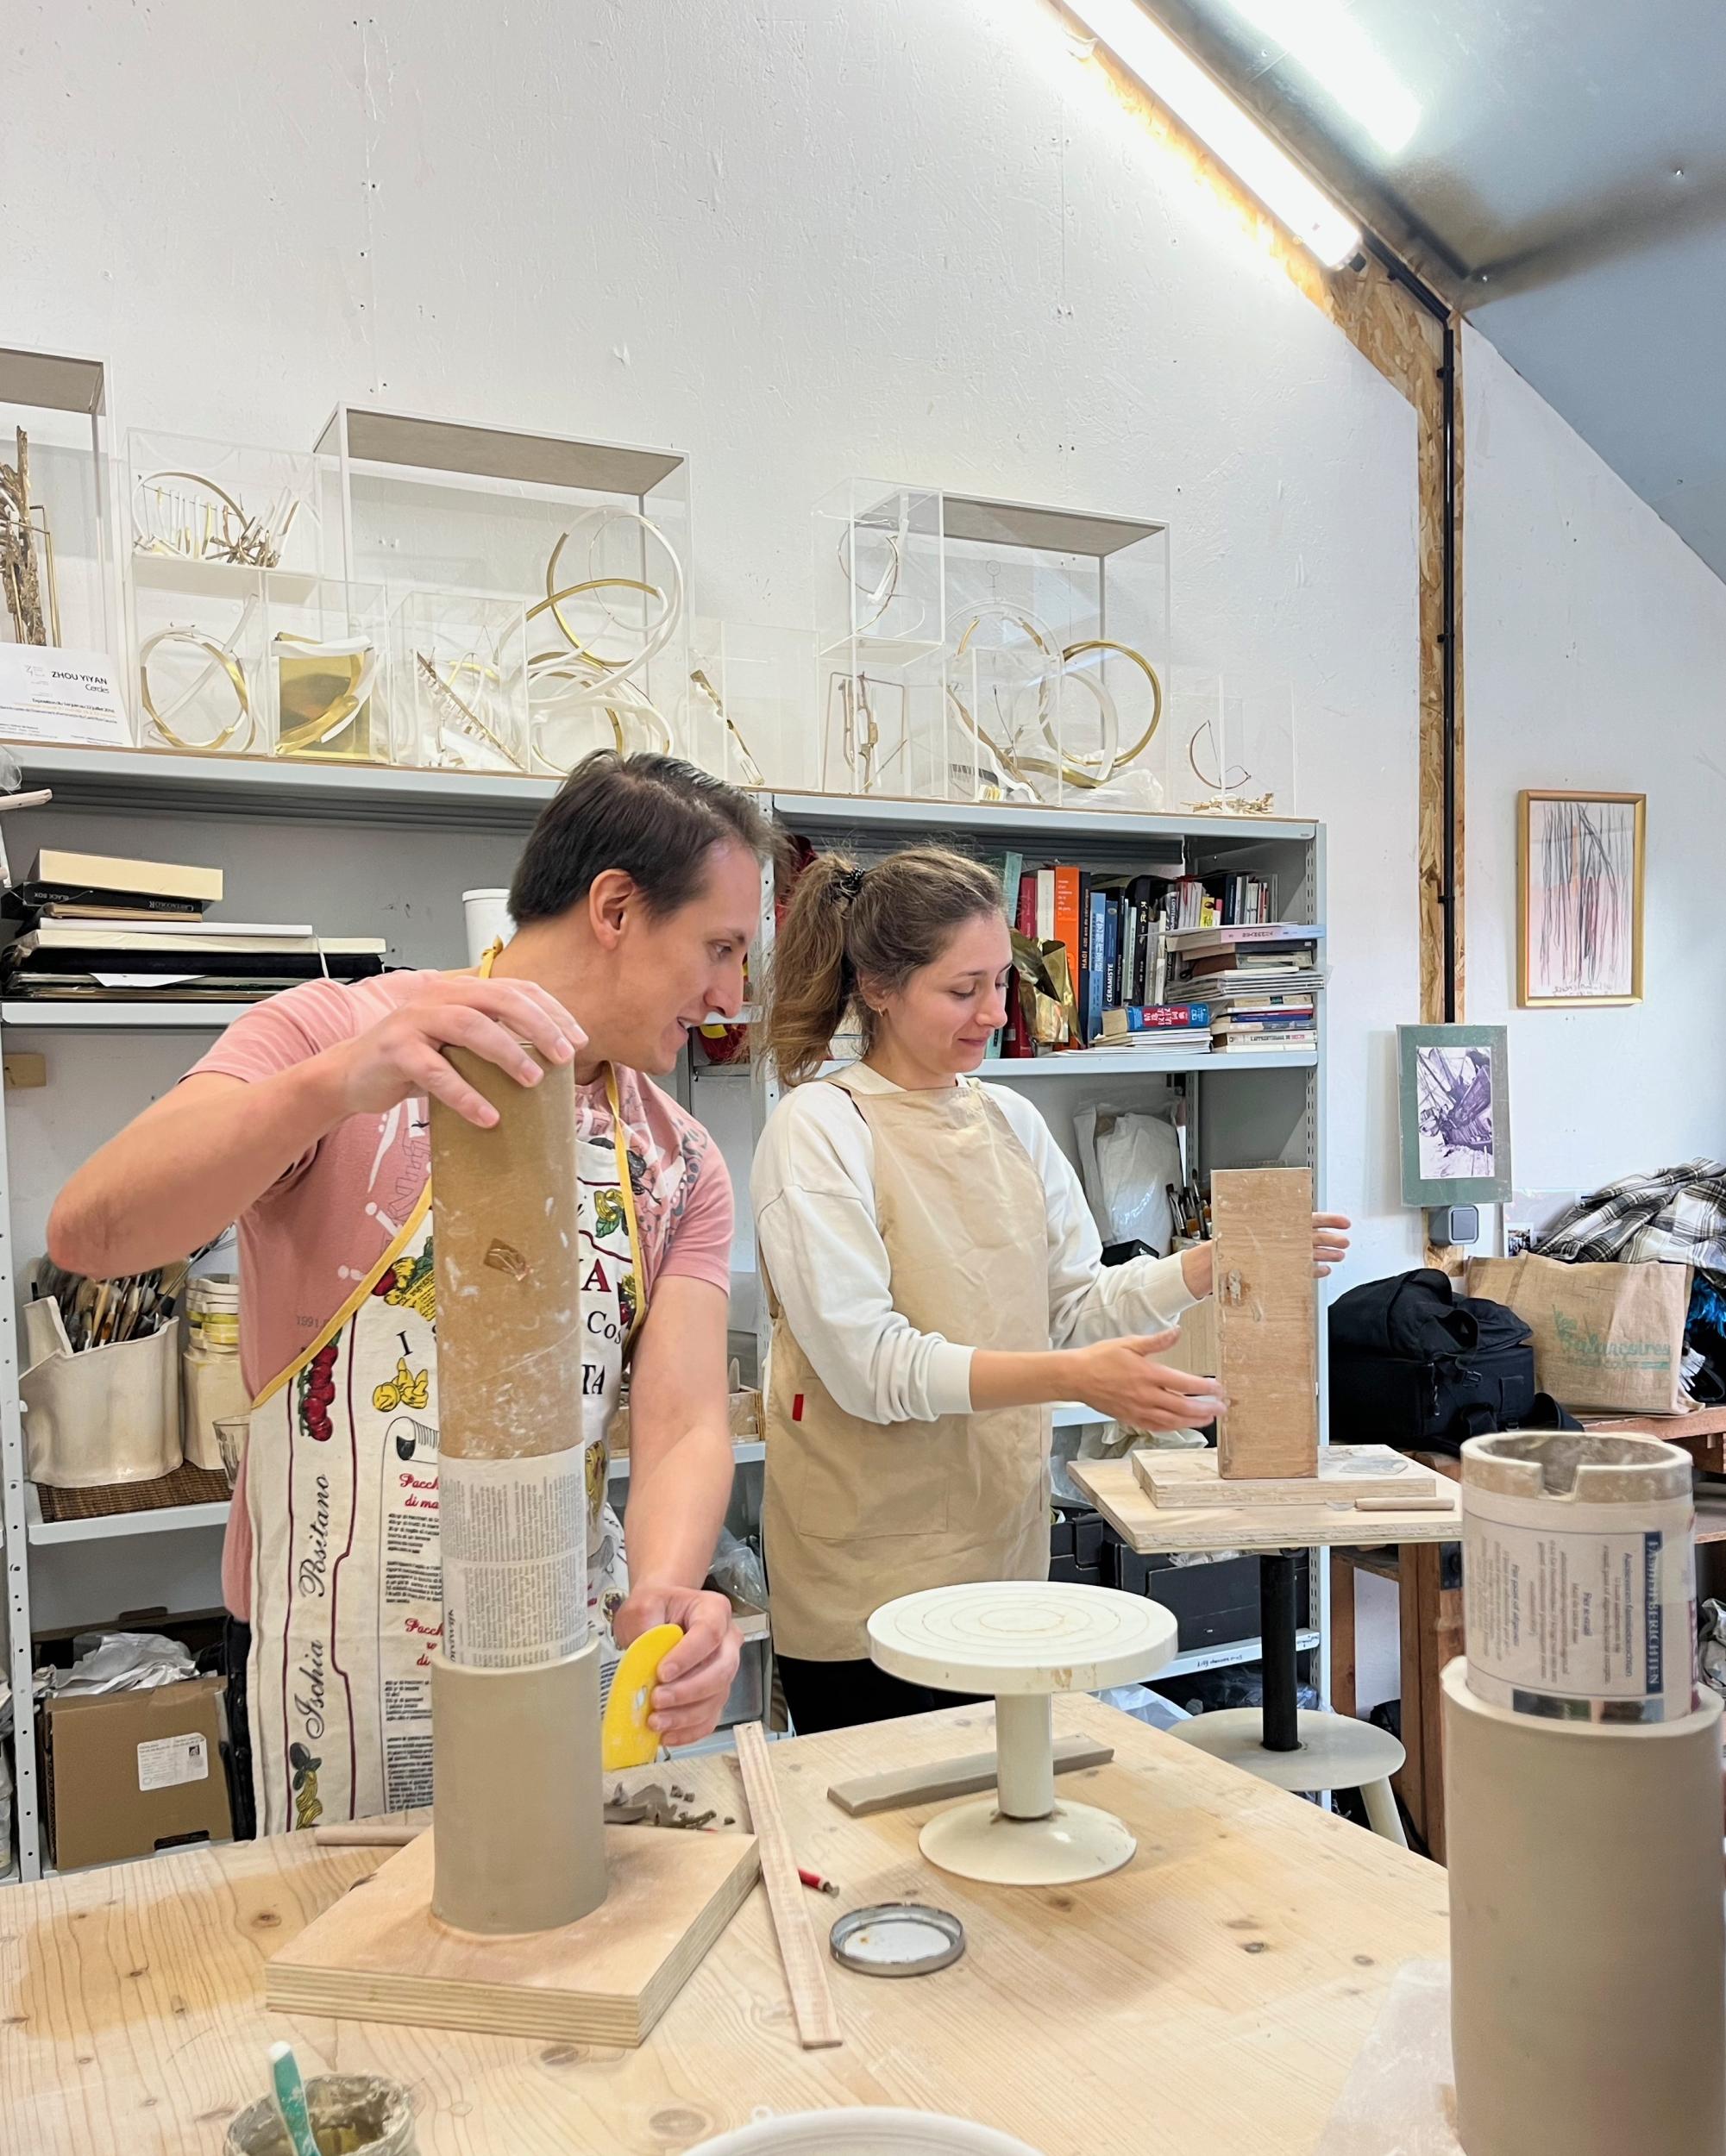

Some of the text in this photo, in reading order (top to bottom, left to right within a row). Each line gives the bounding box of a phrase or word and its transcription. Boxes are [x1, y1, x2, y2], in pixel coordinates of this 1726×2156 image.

[52, 671, 78, 681] ZHOU
[79, 674, 108, 686] YIYAN
[405, 1494, 419, 1507] di
[298, 1474, 330, 1598] Positano
[417, 1653, 430, 1666] di
